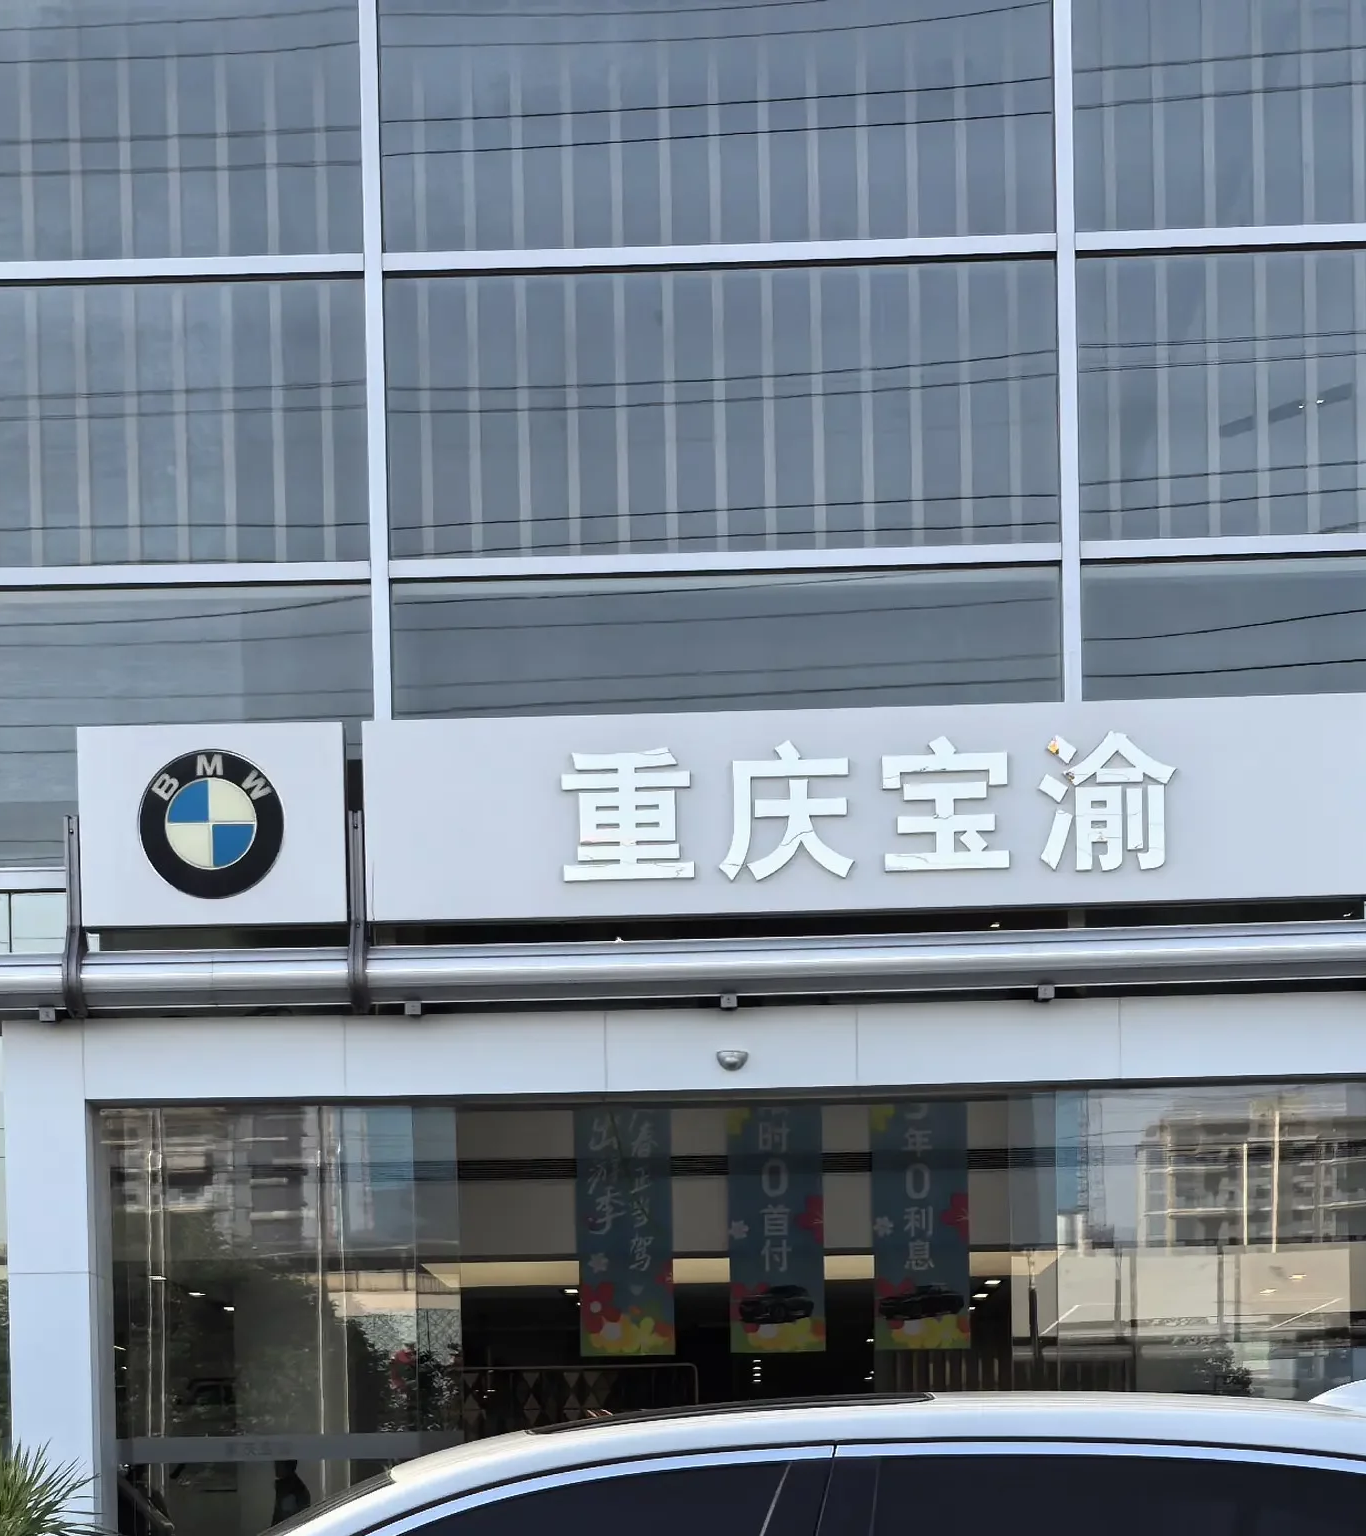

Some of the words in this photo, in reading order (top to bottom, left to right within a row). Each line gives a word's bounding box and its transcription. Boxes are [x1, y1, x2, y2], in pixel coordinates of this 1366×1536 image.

[151, 753, 273, 801] BMW
[561, 730, 1178, 883] 重庆宝渝
